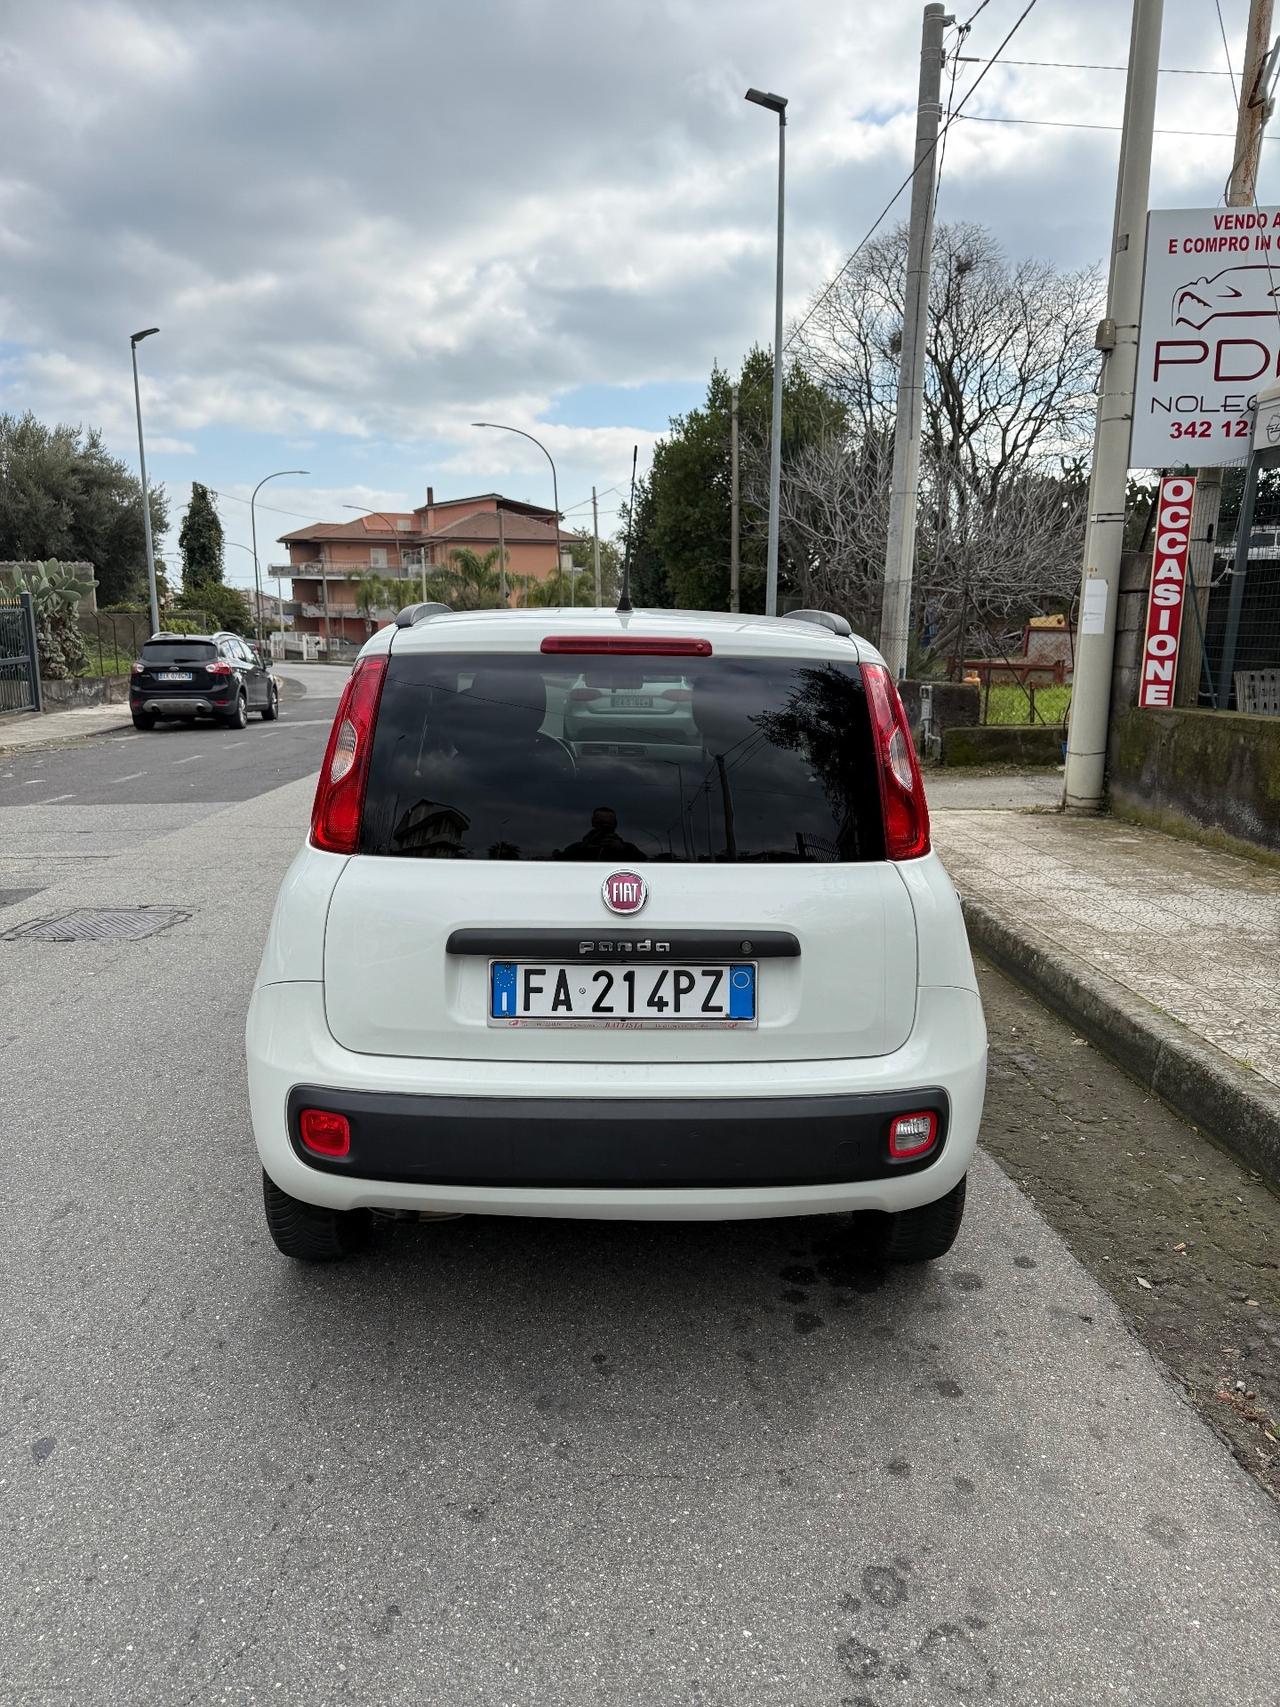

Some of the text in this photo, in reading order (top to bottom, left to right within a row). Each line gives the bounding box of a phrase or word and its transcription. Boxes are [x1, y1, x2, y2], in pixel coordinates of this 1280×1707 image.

[1214, 213, 1268, 230] VENDO
[1168, 239, 1178, 254] E
[1183, 236, 1250, 254] COMPRO
[1255, 235, 1271, 251] IN
[1153, 339, 1280, 382] PD
[1169, 421, 1212, 439] 342
[1145, 479, 1193, 706] OCCASIONE
[613, 883, 638, 902] FIAT
[579, 940, 670, 953] panda
[523, 969, 573, 1011] FA
[592, 969, 724, 1012] 214PZ
